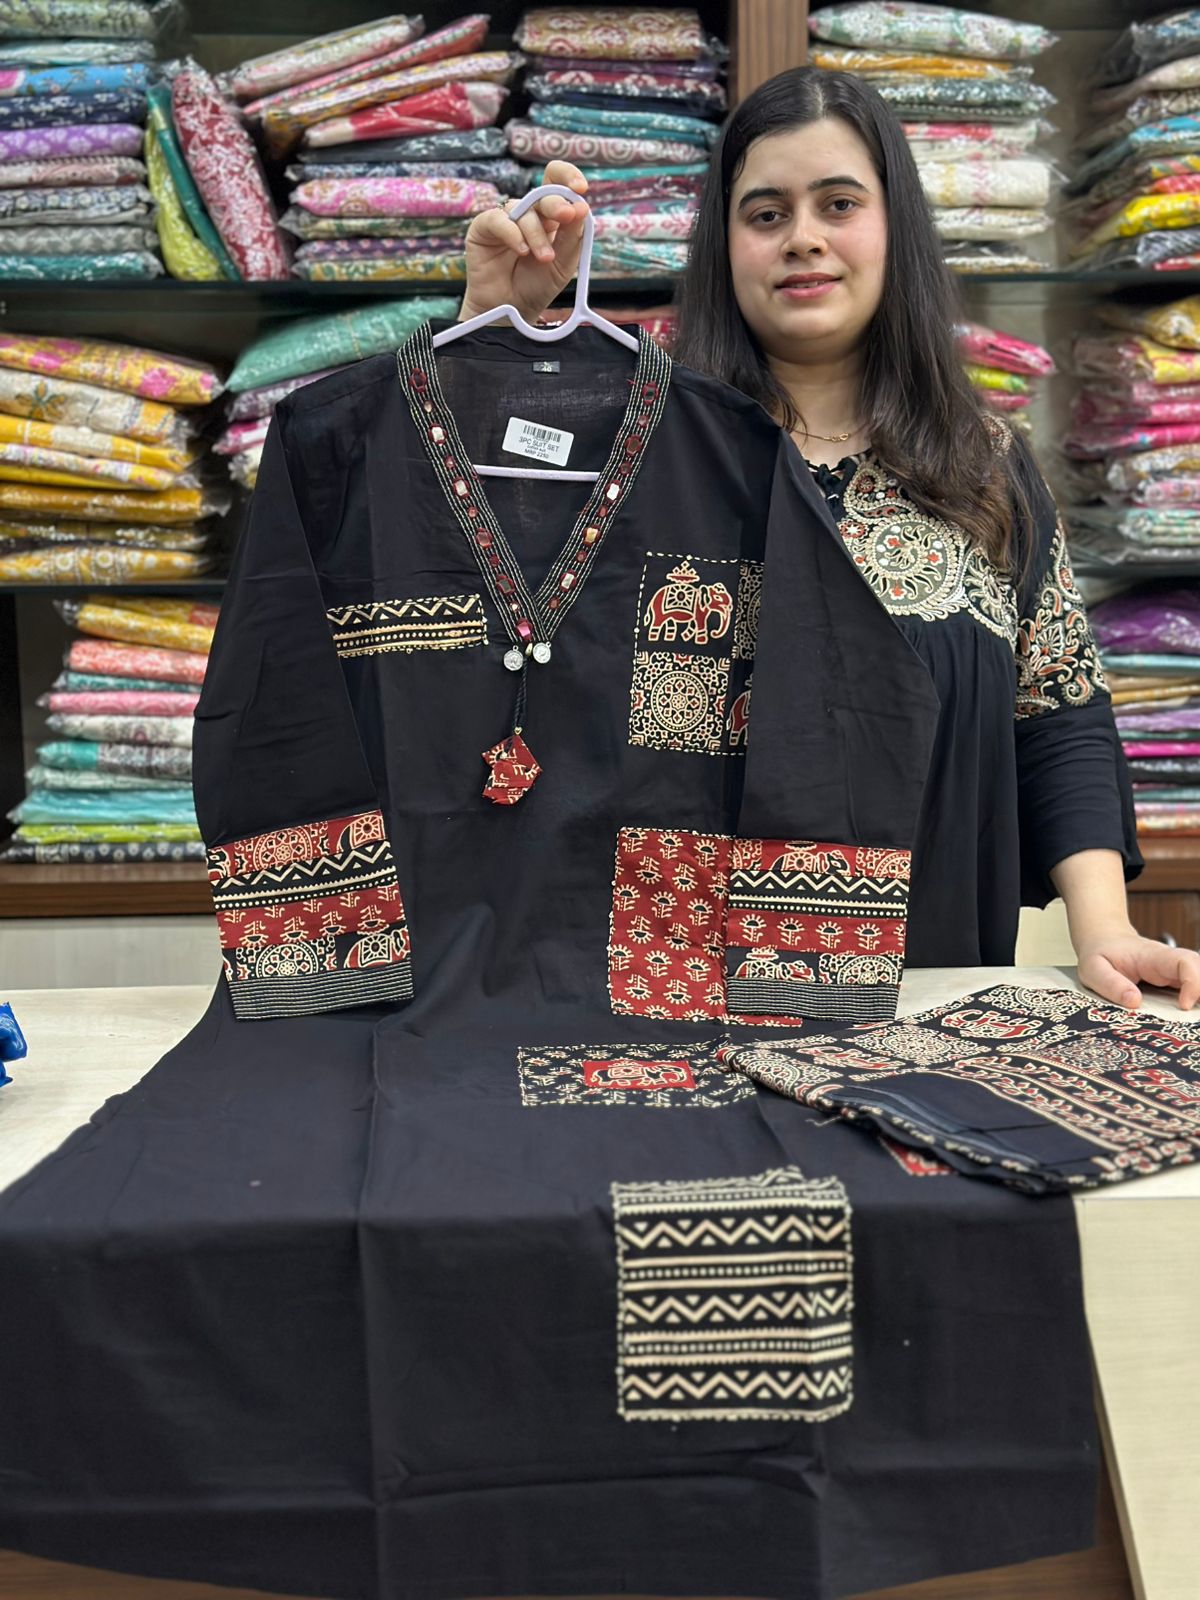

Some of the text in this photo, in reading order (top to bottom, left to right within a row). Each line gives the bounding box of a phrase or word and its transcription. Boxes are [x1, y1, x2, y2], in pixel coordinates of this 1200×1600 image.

[519, 436, 532, 445] 3PC
[532, 439, 546, 448] SUIT
[547, 444, 560, 452] SET
